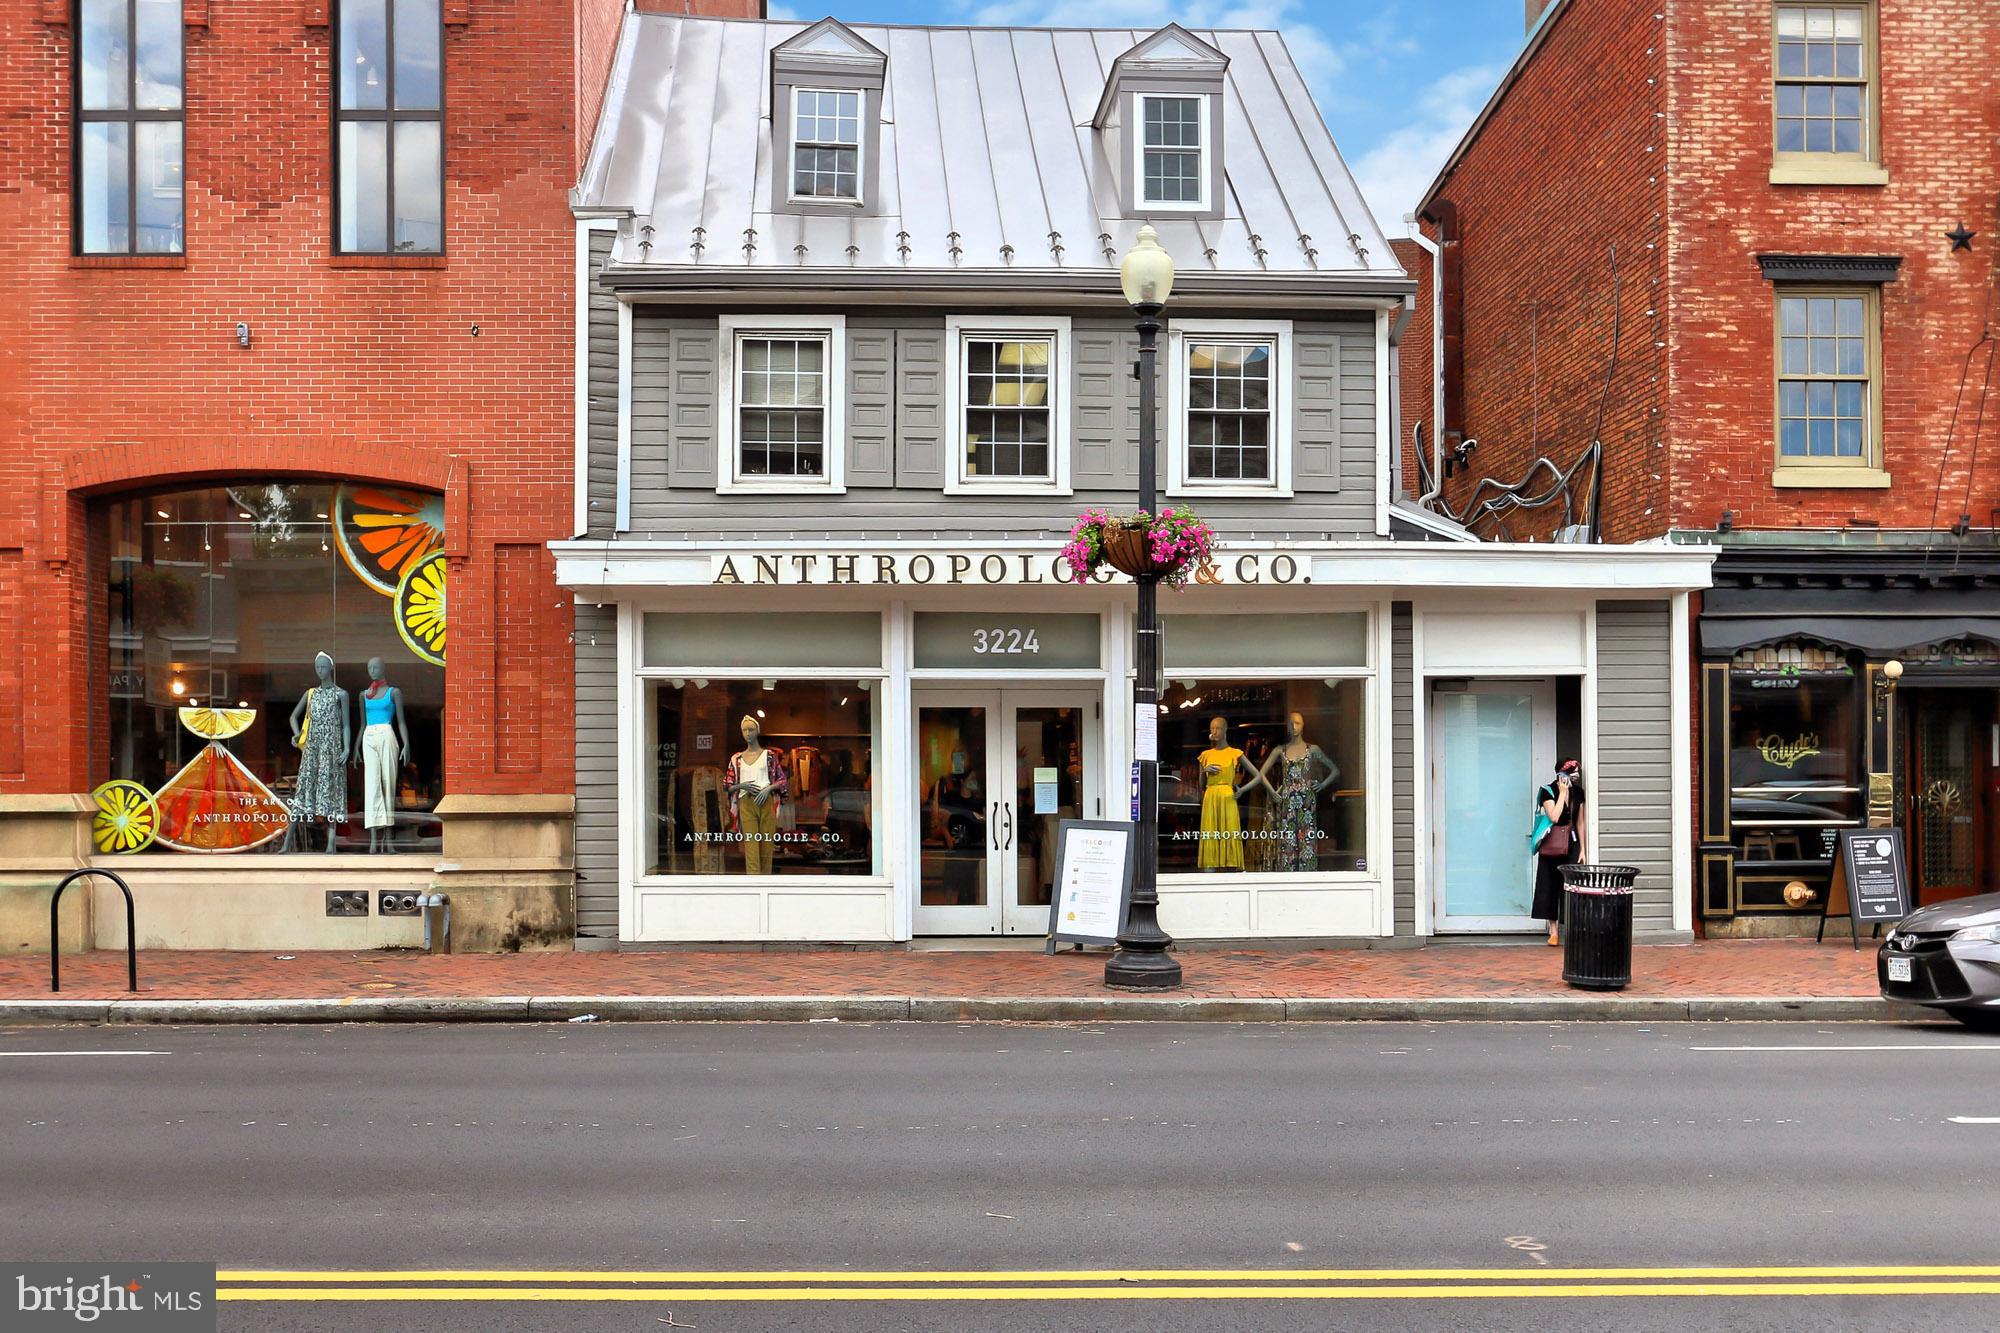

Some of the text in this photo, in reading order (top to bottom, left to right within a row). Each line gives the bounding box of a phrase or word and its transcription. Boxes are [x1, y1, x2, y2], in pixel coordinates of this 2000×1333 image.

[712, 551, 1312, 585] ANTHROPOLO & CO.
[972, 628, 1040, 654] 3224
[1755, 732, 1821, 769] Clyde's
[239, 798, 258, 806] THE
[263, 798, 281, 806] ART
[193, 813, 314, 823] ANTHROPOLOGIE
[327, 813, 349, 824] CO.
[683, 832, 809, 842] ANTHROPOLOGIE
[822, 832, 844, 842] CO.
[1171, 830, 1294, 840] ANTHROPOLOGIE
[1307, 830, 1329, 840] CO.
